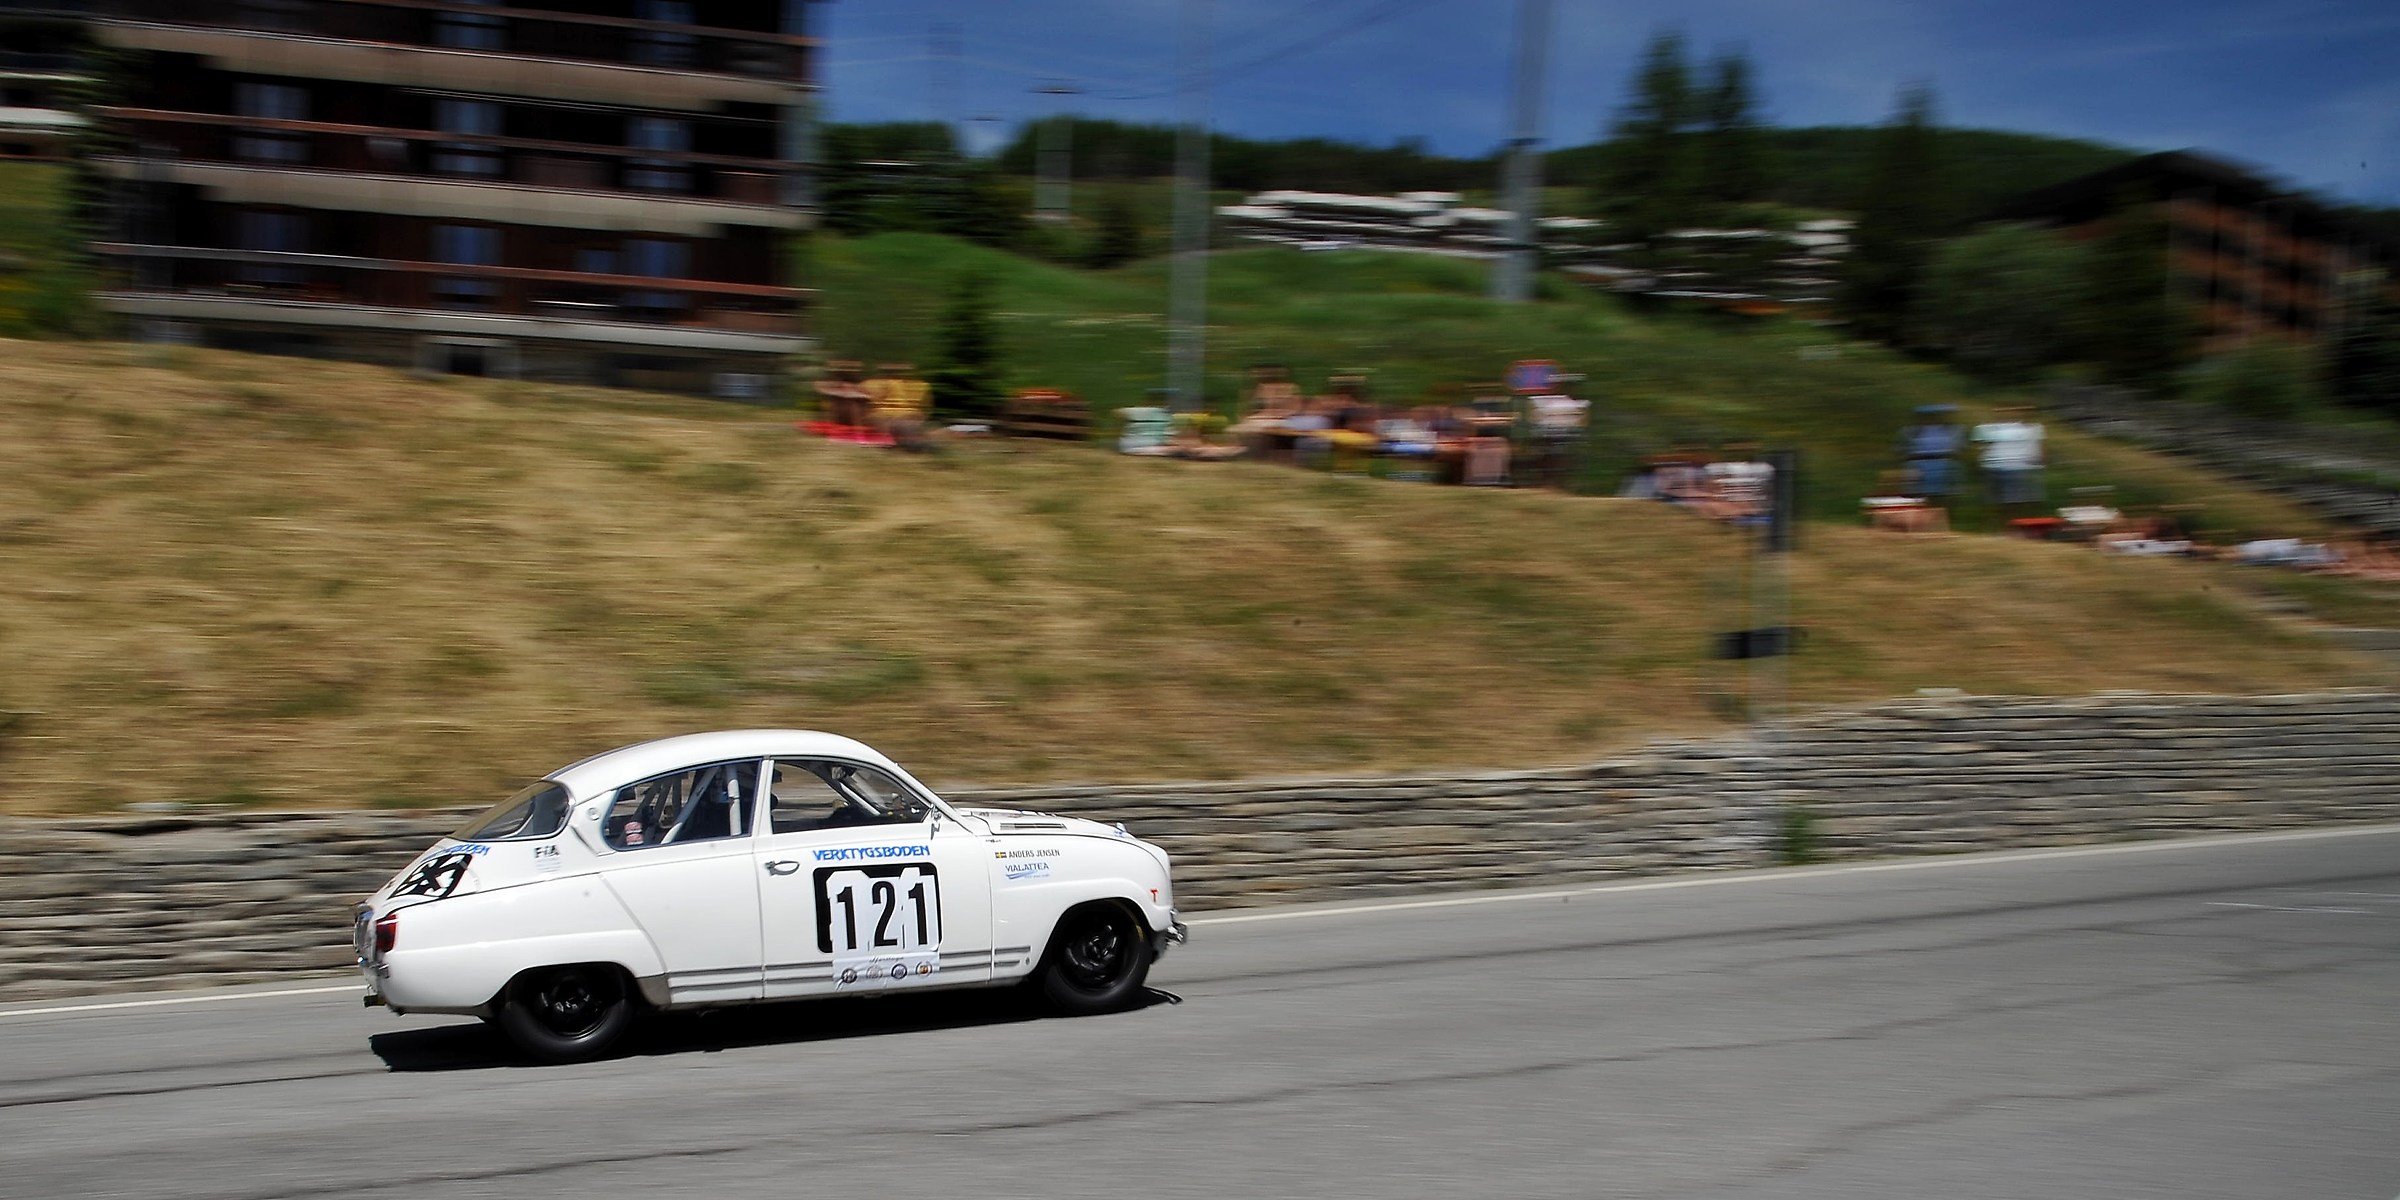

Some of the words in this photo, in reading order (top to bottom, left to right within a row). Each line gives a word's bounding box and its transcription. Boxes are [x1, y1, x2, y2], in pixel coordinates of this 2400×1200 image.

[812, 845, 931, 861] VERKTYGSBODEN
[1008, 849, 1035, 858] ANDERS
[1036, 848, 1061, 857] JENSEN
[836, 880, 928, 950] 121
